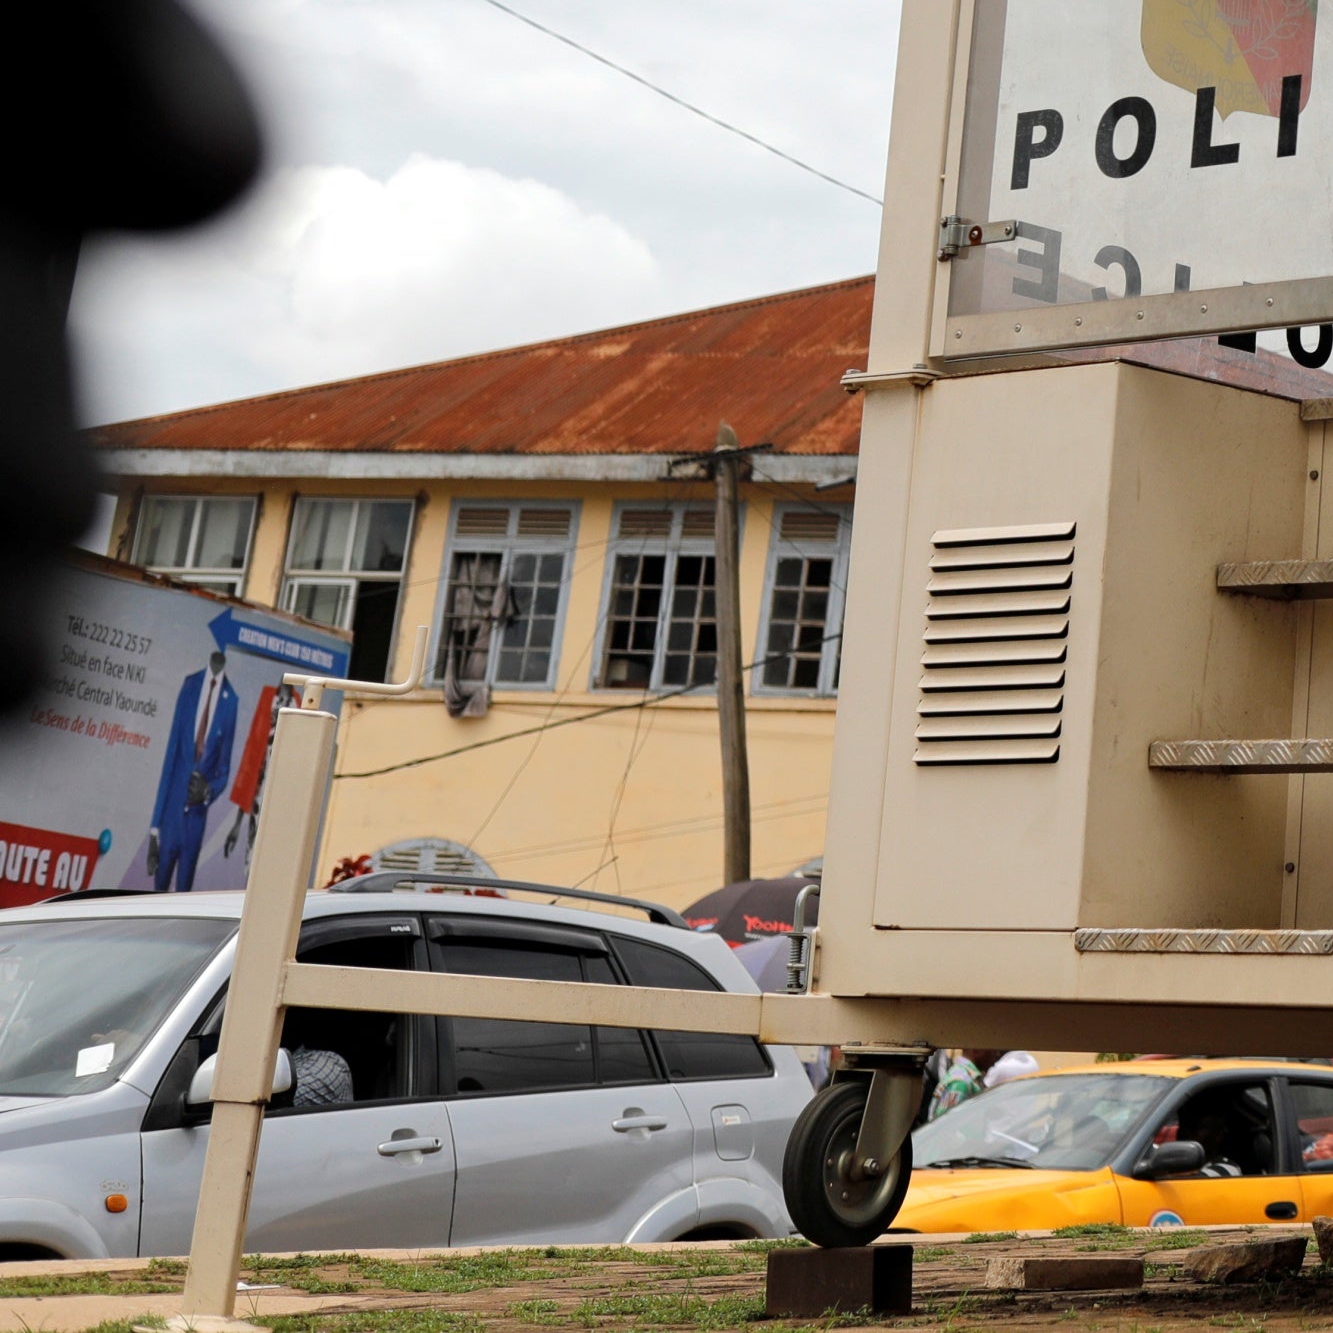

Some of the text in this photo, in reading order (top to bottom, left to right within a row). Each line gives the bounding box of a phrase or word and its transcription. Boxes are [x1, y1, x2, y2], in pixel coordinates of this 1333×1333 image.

[90, 623, 108, 645] 222
[110, 627, 123, 649] 22
[124, 632, 138, 653] 25
[139, 637, 152, 655] 57
[88, 656, 101, 674] en
[102, 655, 124, 679] face
[77, 680, 113, 707] Central
[115, 690, 158, 717] Yaoundé
[70, 714, 85, 734] de
[85, 718, 97, 737] la
[52, 851, 88, 892] AU
